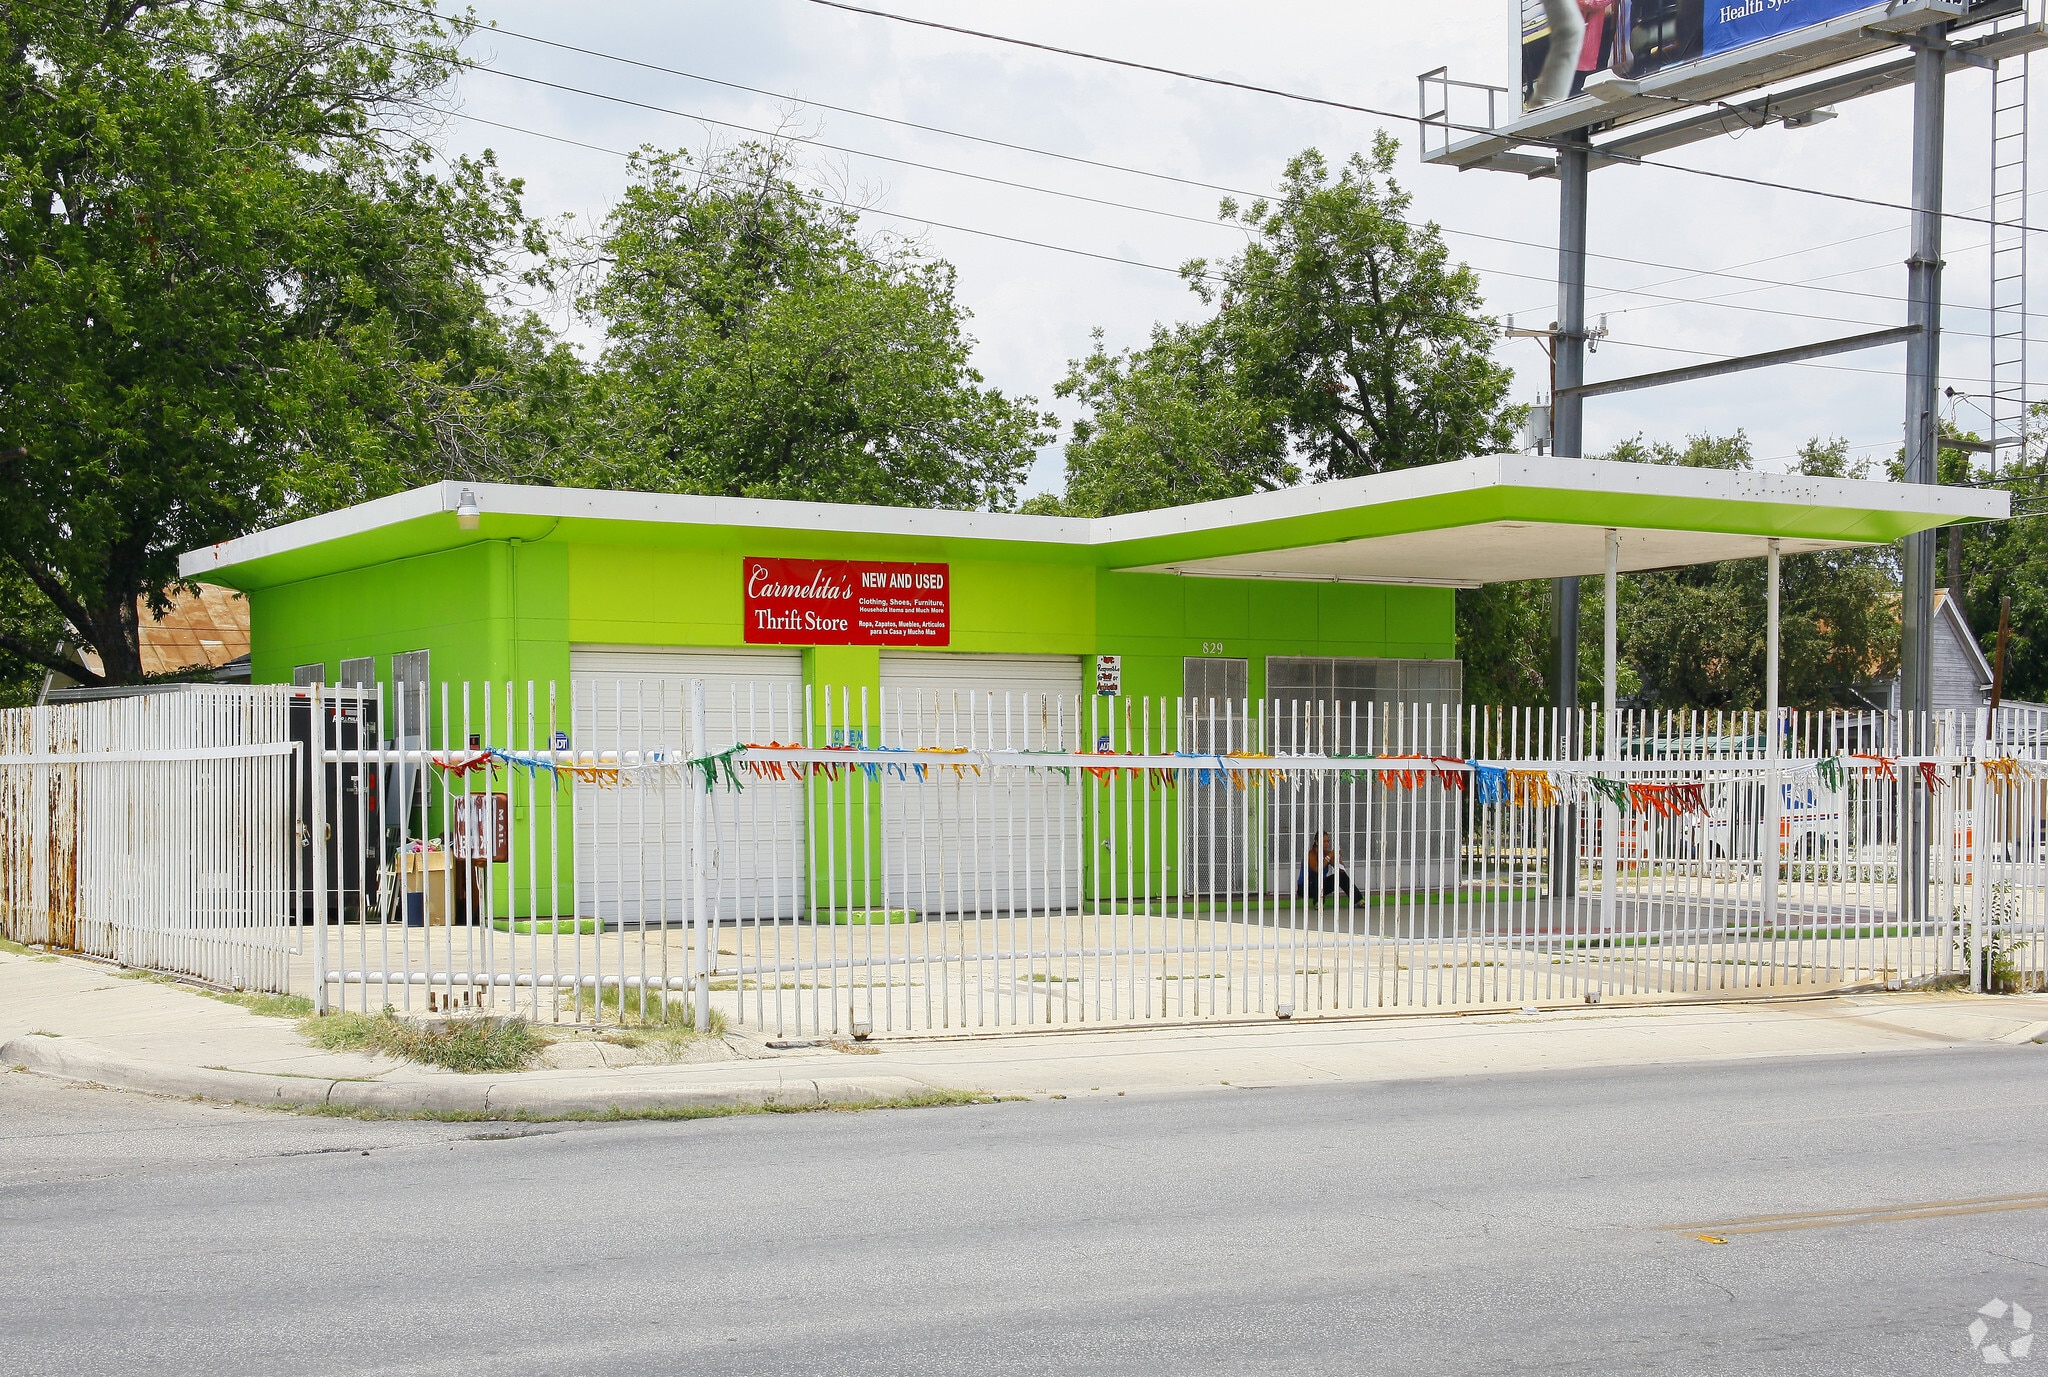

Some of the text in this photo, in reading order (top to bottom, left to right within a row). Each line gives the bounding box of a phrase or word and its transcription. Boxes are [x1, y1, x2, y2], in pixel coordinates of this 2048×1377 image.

[1719, 0, 1764, 24] Health
[748, 563, 854, 600] Carmelita's
[862, 572, 944, 590] NEW AND USED
[858, 597, 945, 607] Clothing, Shoes, Furniture,
[754, 608, 848, 631] Thrift Store
[858, 620, 874, 628] Ropa,
[874, 620, 898, 628] Zapatos,
[1202, 642, 1224, 655] 829
[834, 729, 863, 741] OEN
